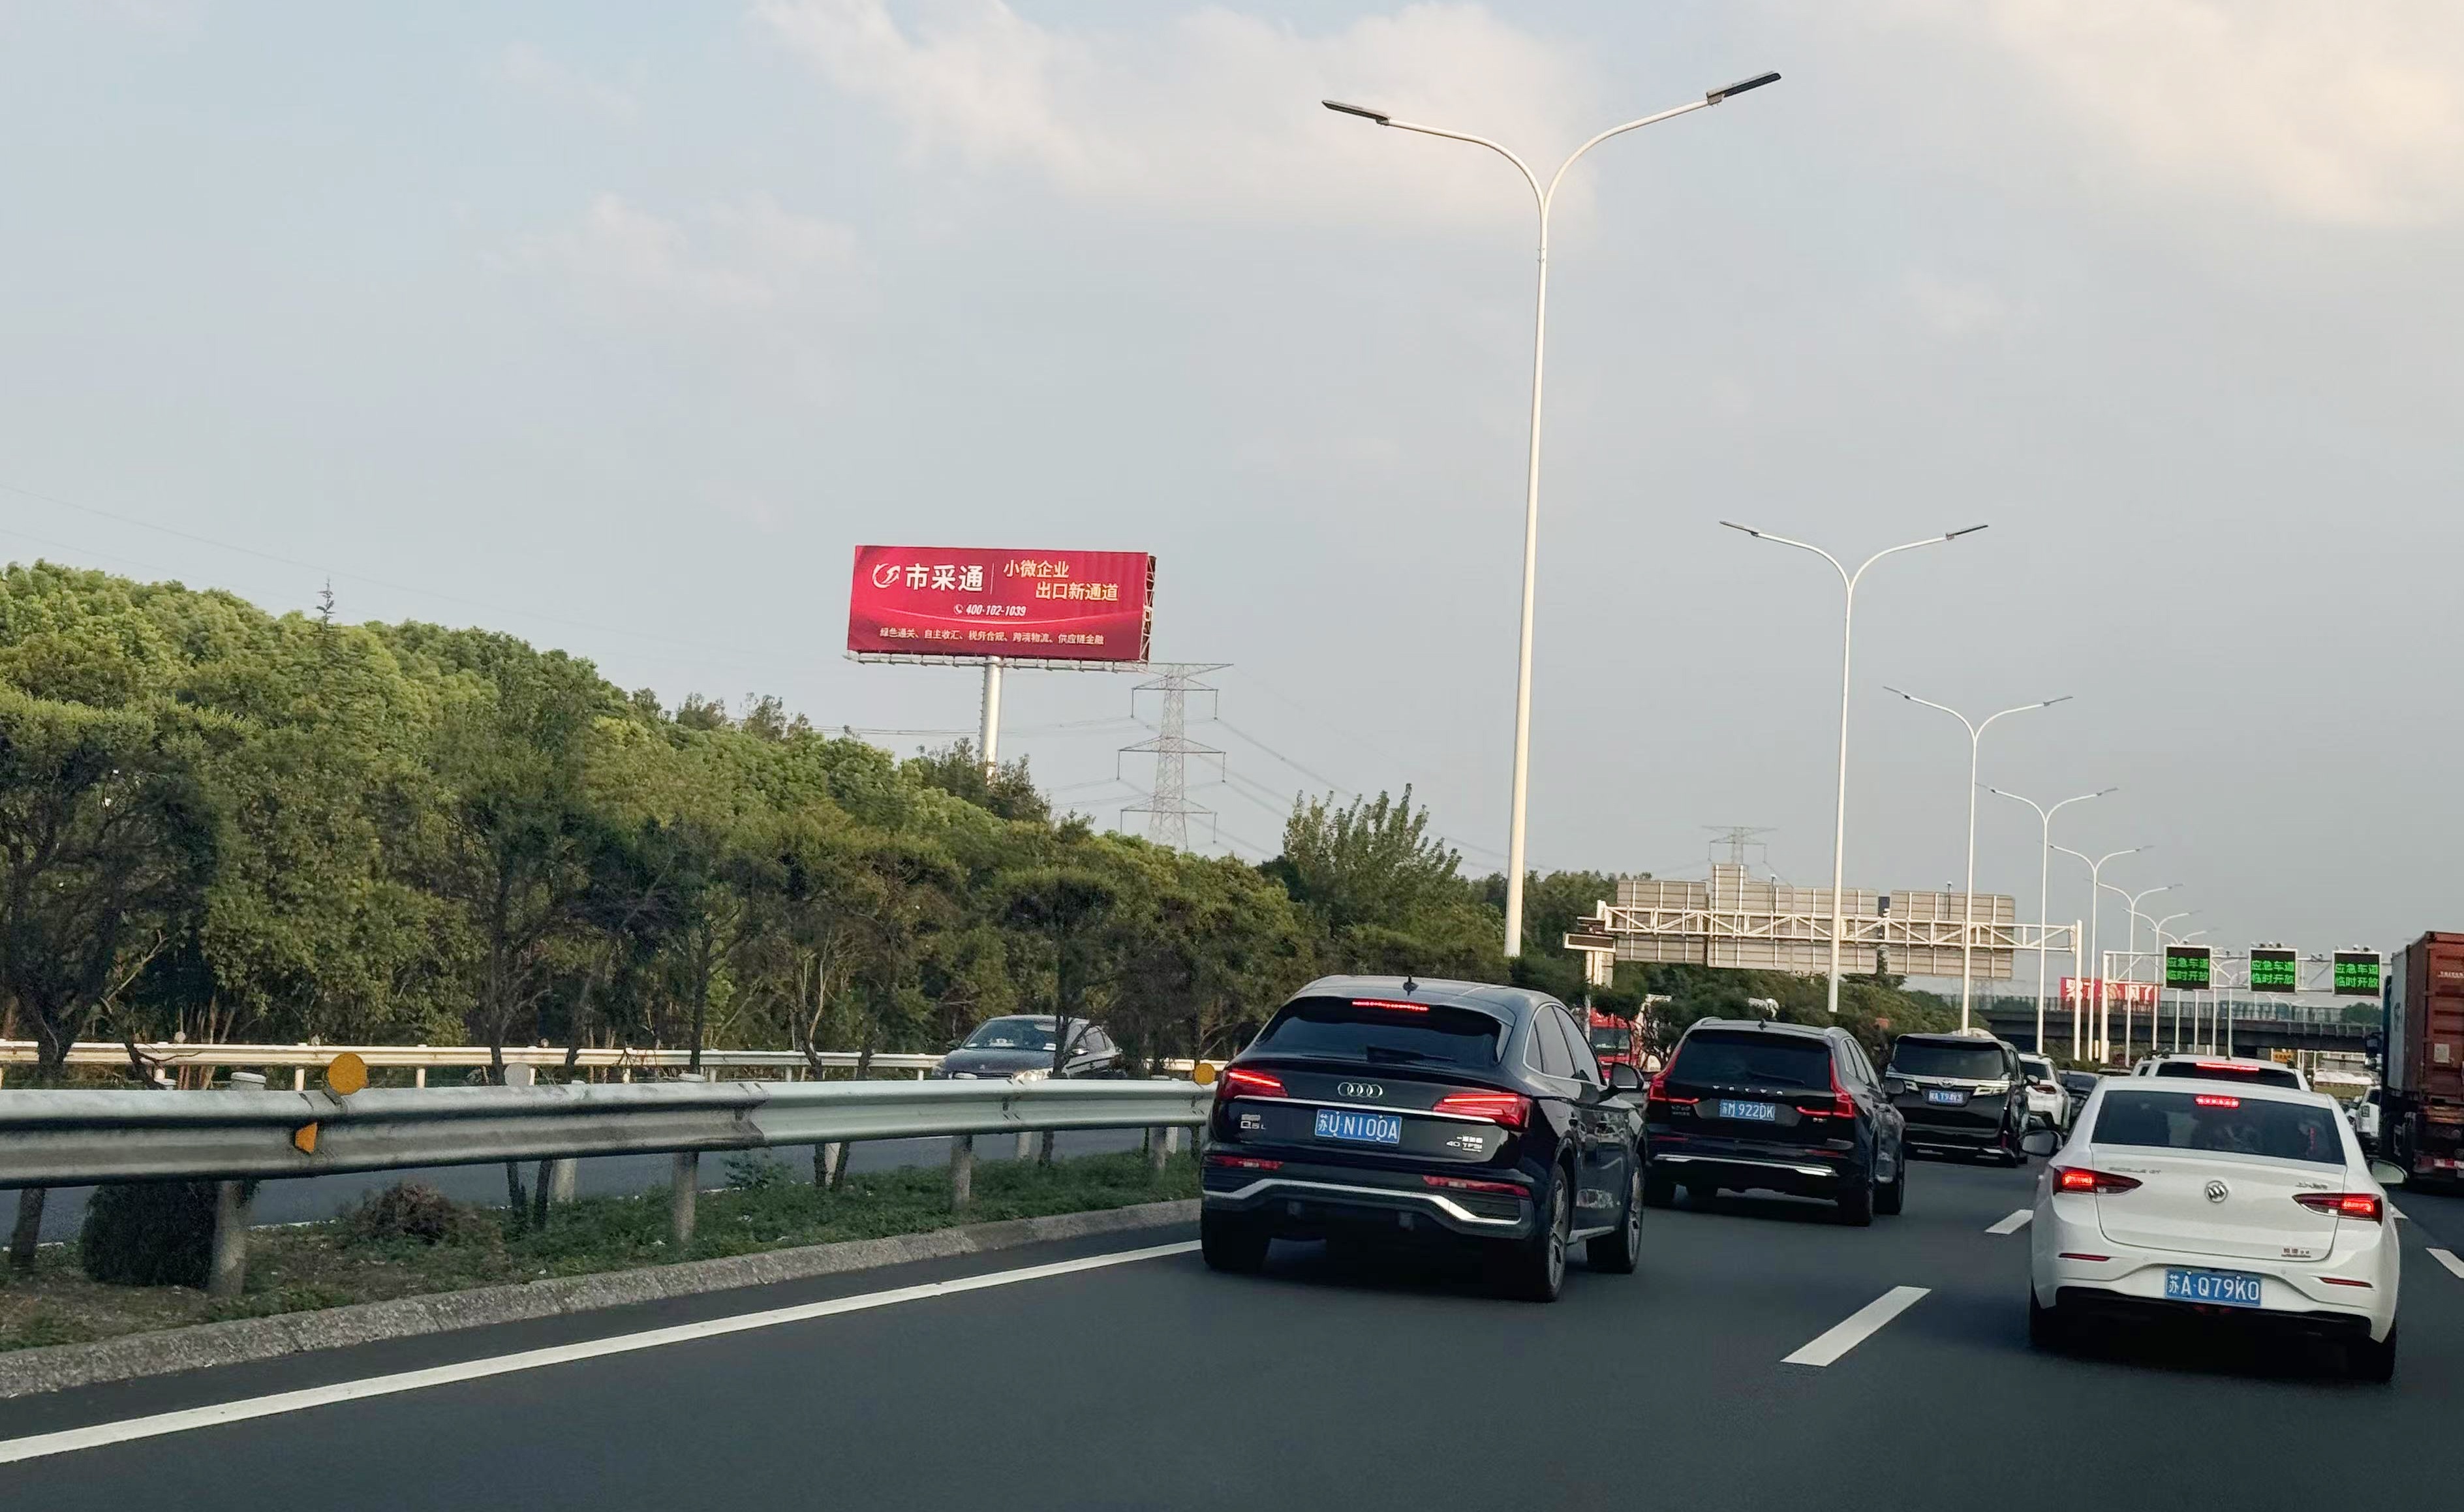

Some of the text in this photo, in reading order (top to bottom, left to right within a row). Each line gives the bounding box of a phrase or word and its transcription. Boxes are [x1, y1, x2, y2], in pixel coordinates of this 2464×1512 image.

[1003, 560, 1070, 579] 小微企业
[905, 563, 984, 592] 市采通
[1035, 581, 1119, 602] 出口新通道
[2167, 957, 2209, 969] 应急车道
[2251, 960, 2295, 972] 应急车道
[2335, 963, 2379, 975] 应急车道
[2251, 973, 2295, 985] 临时开放
[2335, 976, 2379, 988] 临时开放
